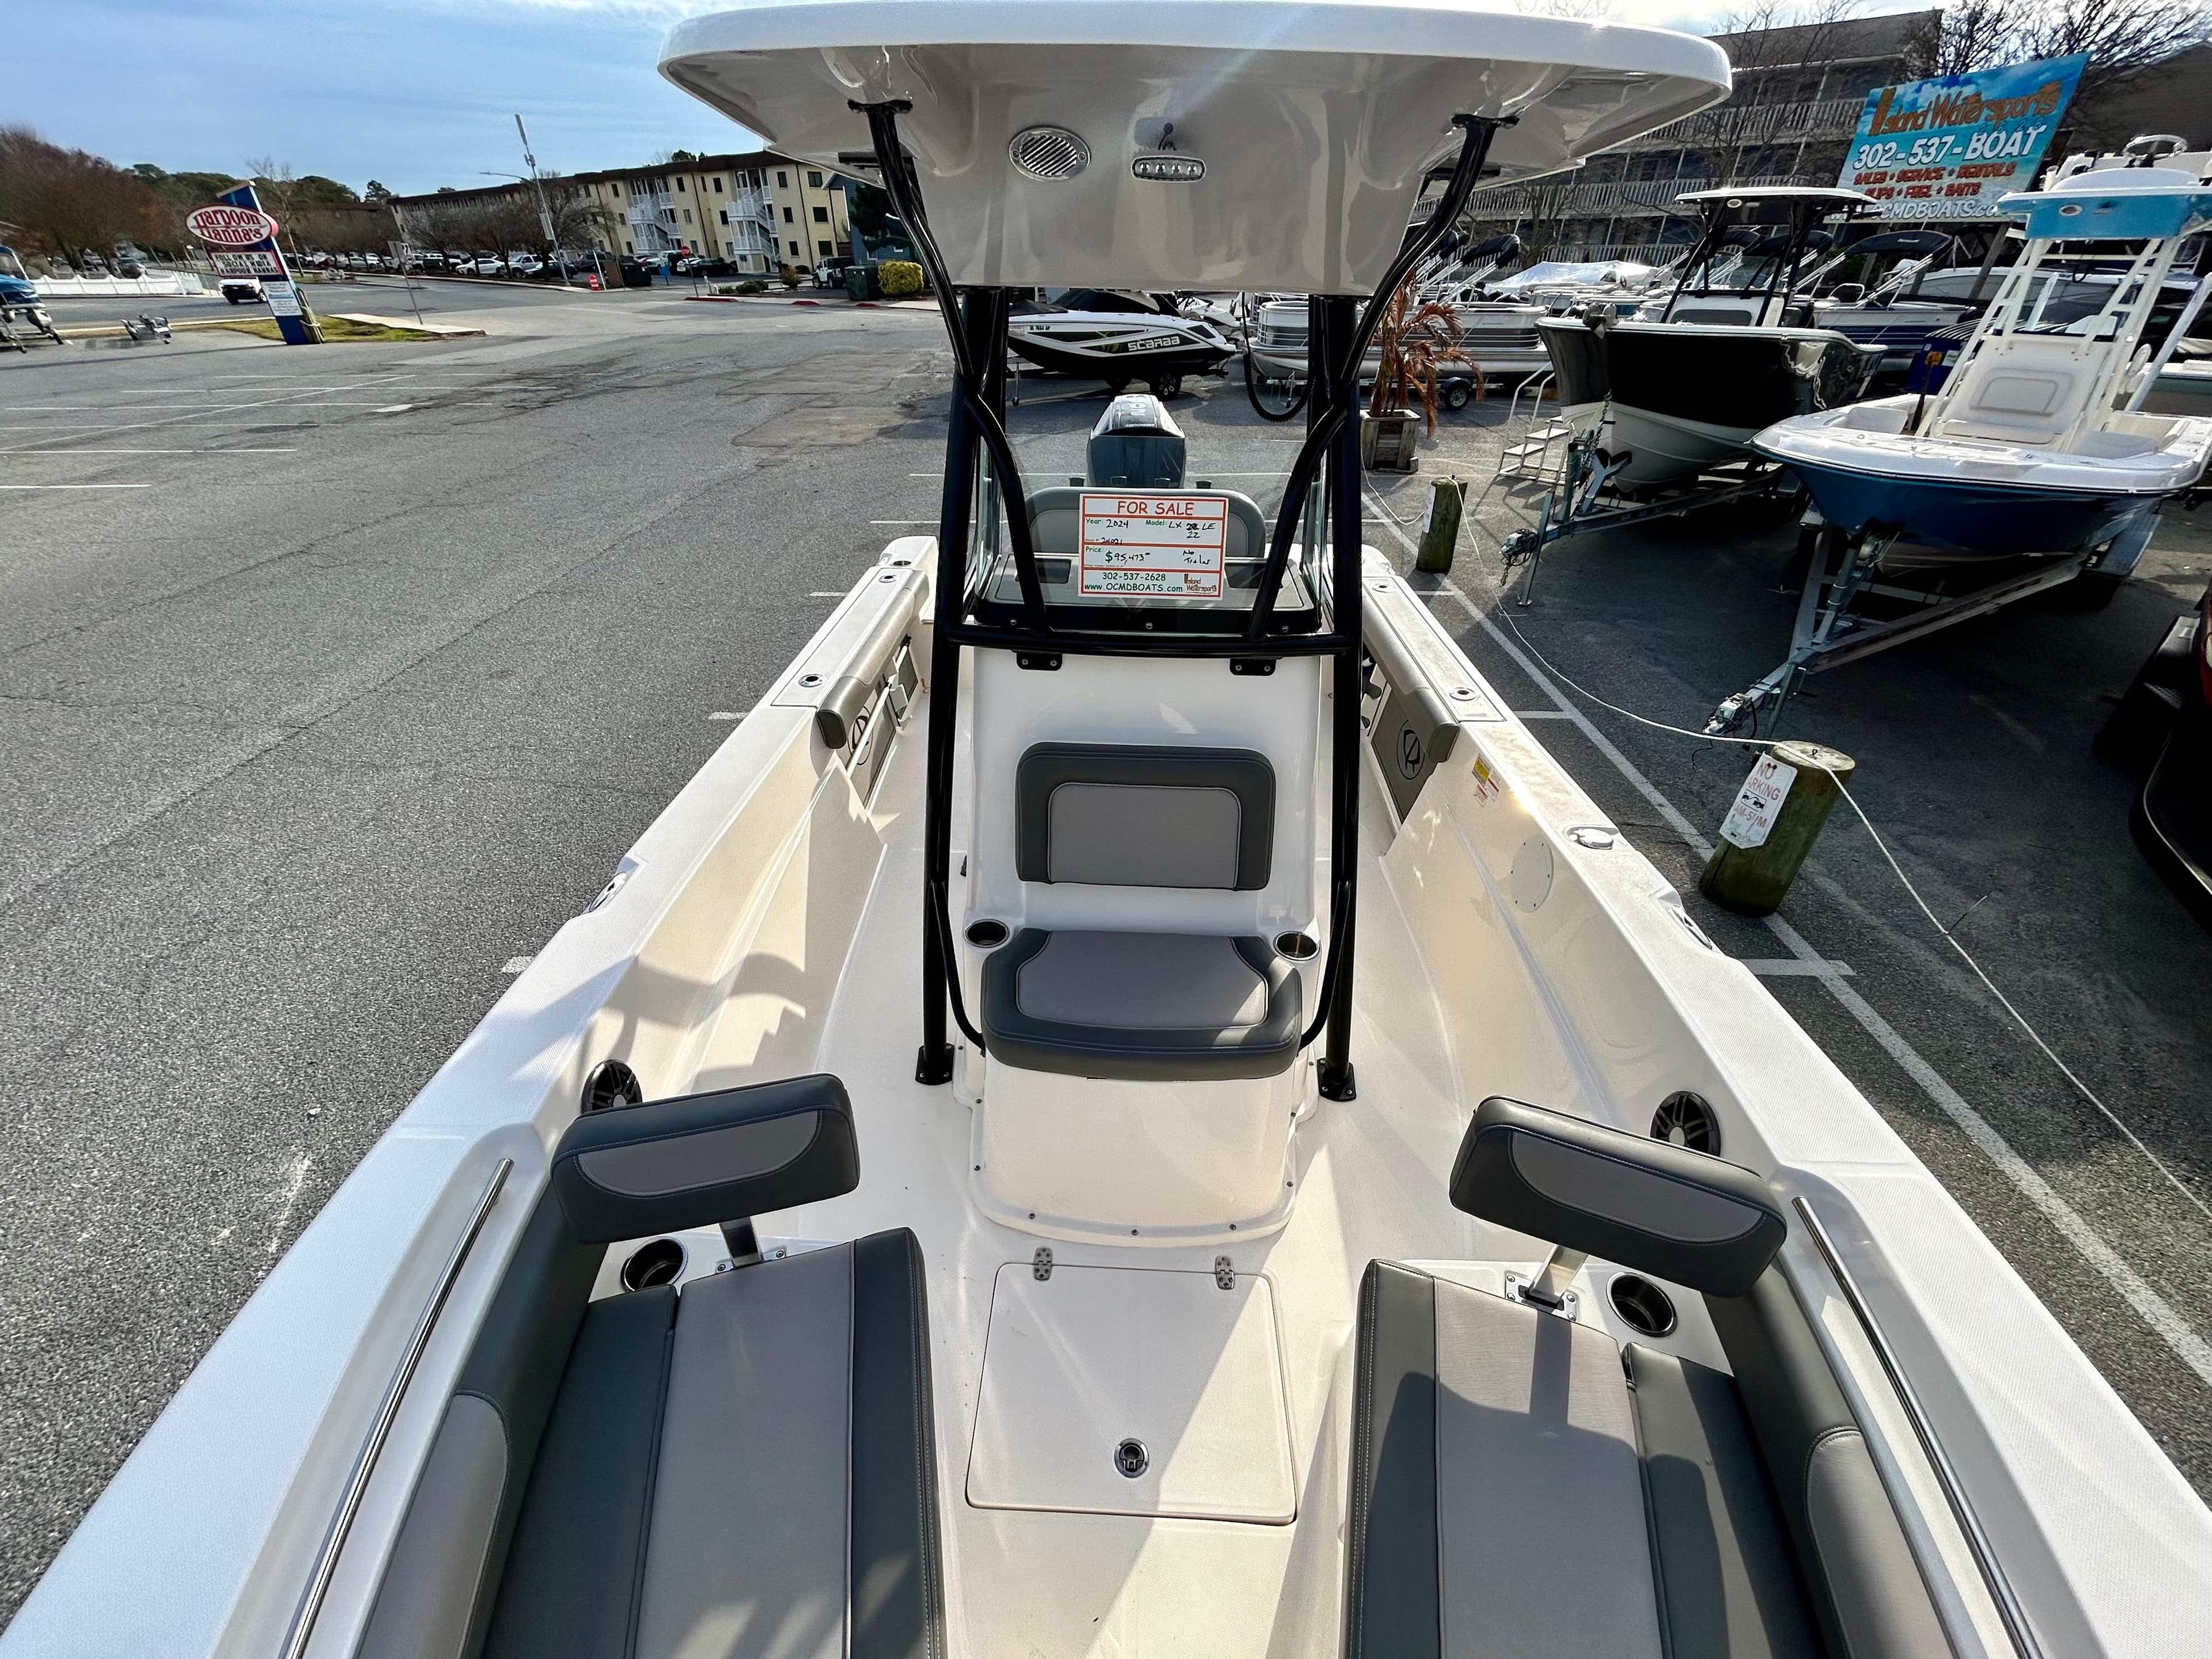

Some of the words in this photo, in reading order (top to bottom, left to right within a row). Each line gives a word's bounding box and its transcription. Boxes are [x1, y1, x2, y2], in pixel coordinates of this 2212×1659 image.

[1868, 87, 1933, 137] Island
[1930, 81, 2062, 130] Watersports
[1854, 171, 1888, 185] SALES
[1896, 167, 1945, 183] SERVICE
[1957, 161, 2017, 179] RENTALS
[1904, 185, 1932, 198] FUEL
[193, 210, 261, 229] Harpoon
[199, 227, 263, 243] Hanna's
[1127, 336, 1180, 352] SCARAB
[1117, 501, 1147, 514] FOR
[1155, 502, 1194, 516] SALE
[1106, 519, 1128, 528] 2024
[1102, 572, 1166, 581] 302-537-2628
[1757, 762, 1776, 780] NO
